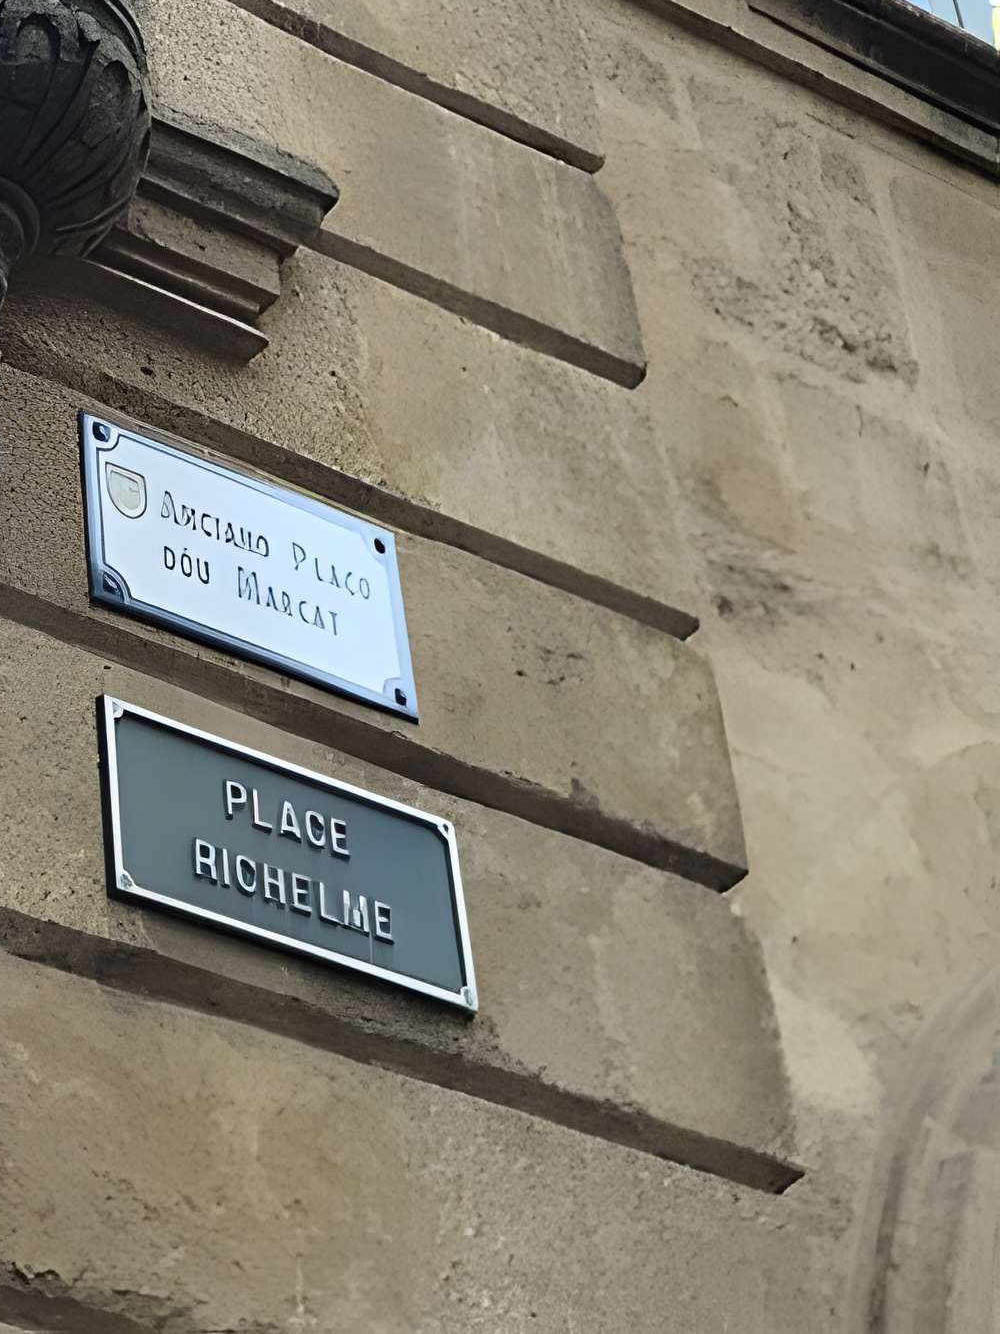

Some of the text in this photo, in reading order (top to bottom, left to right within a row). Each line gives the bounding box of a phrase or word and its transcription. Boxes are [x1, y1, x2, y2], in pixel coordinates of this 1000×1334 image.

[237, 565, 339, 636] MARCAT
[224, 779, 351, 857] PLACE
[194, 837, 394, 944] RICHELME
